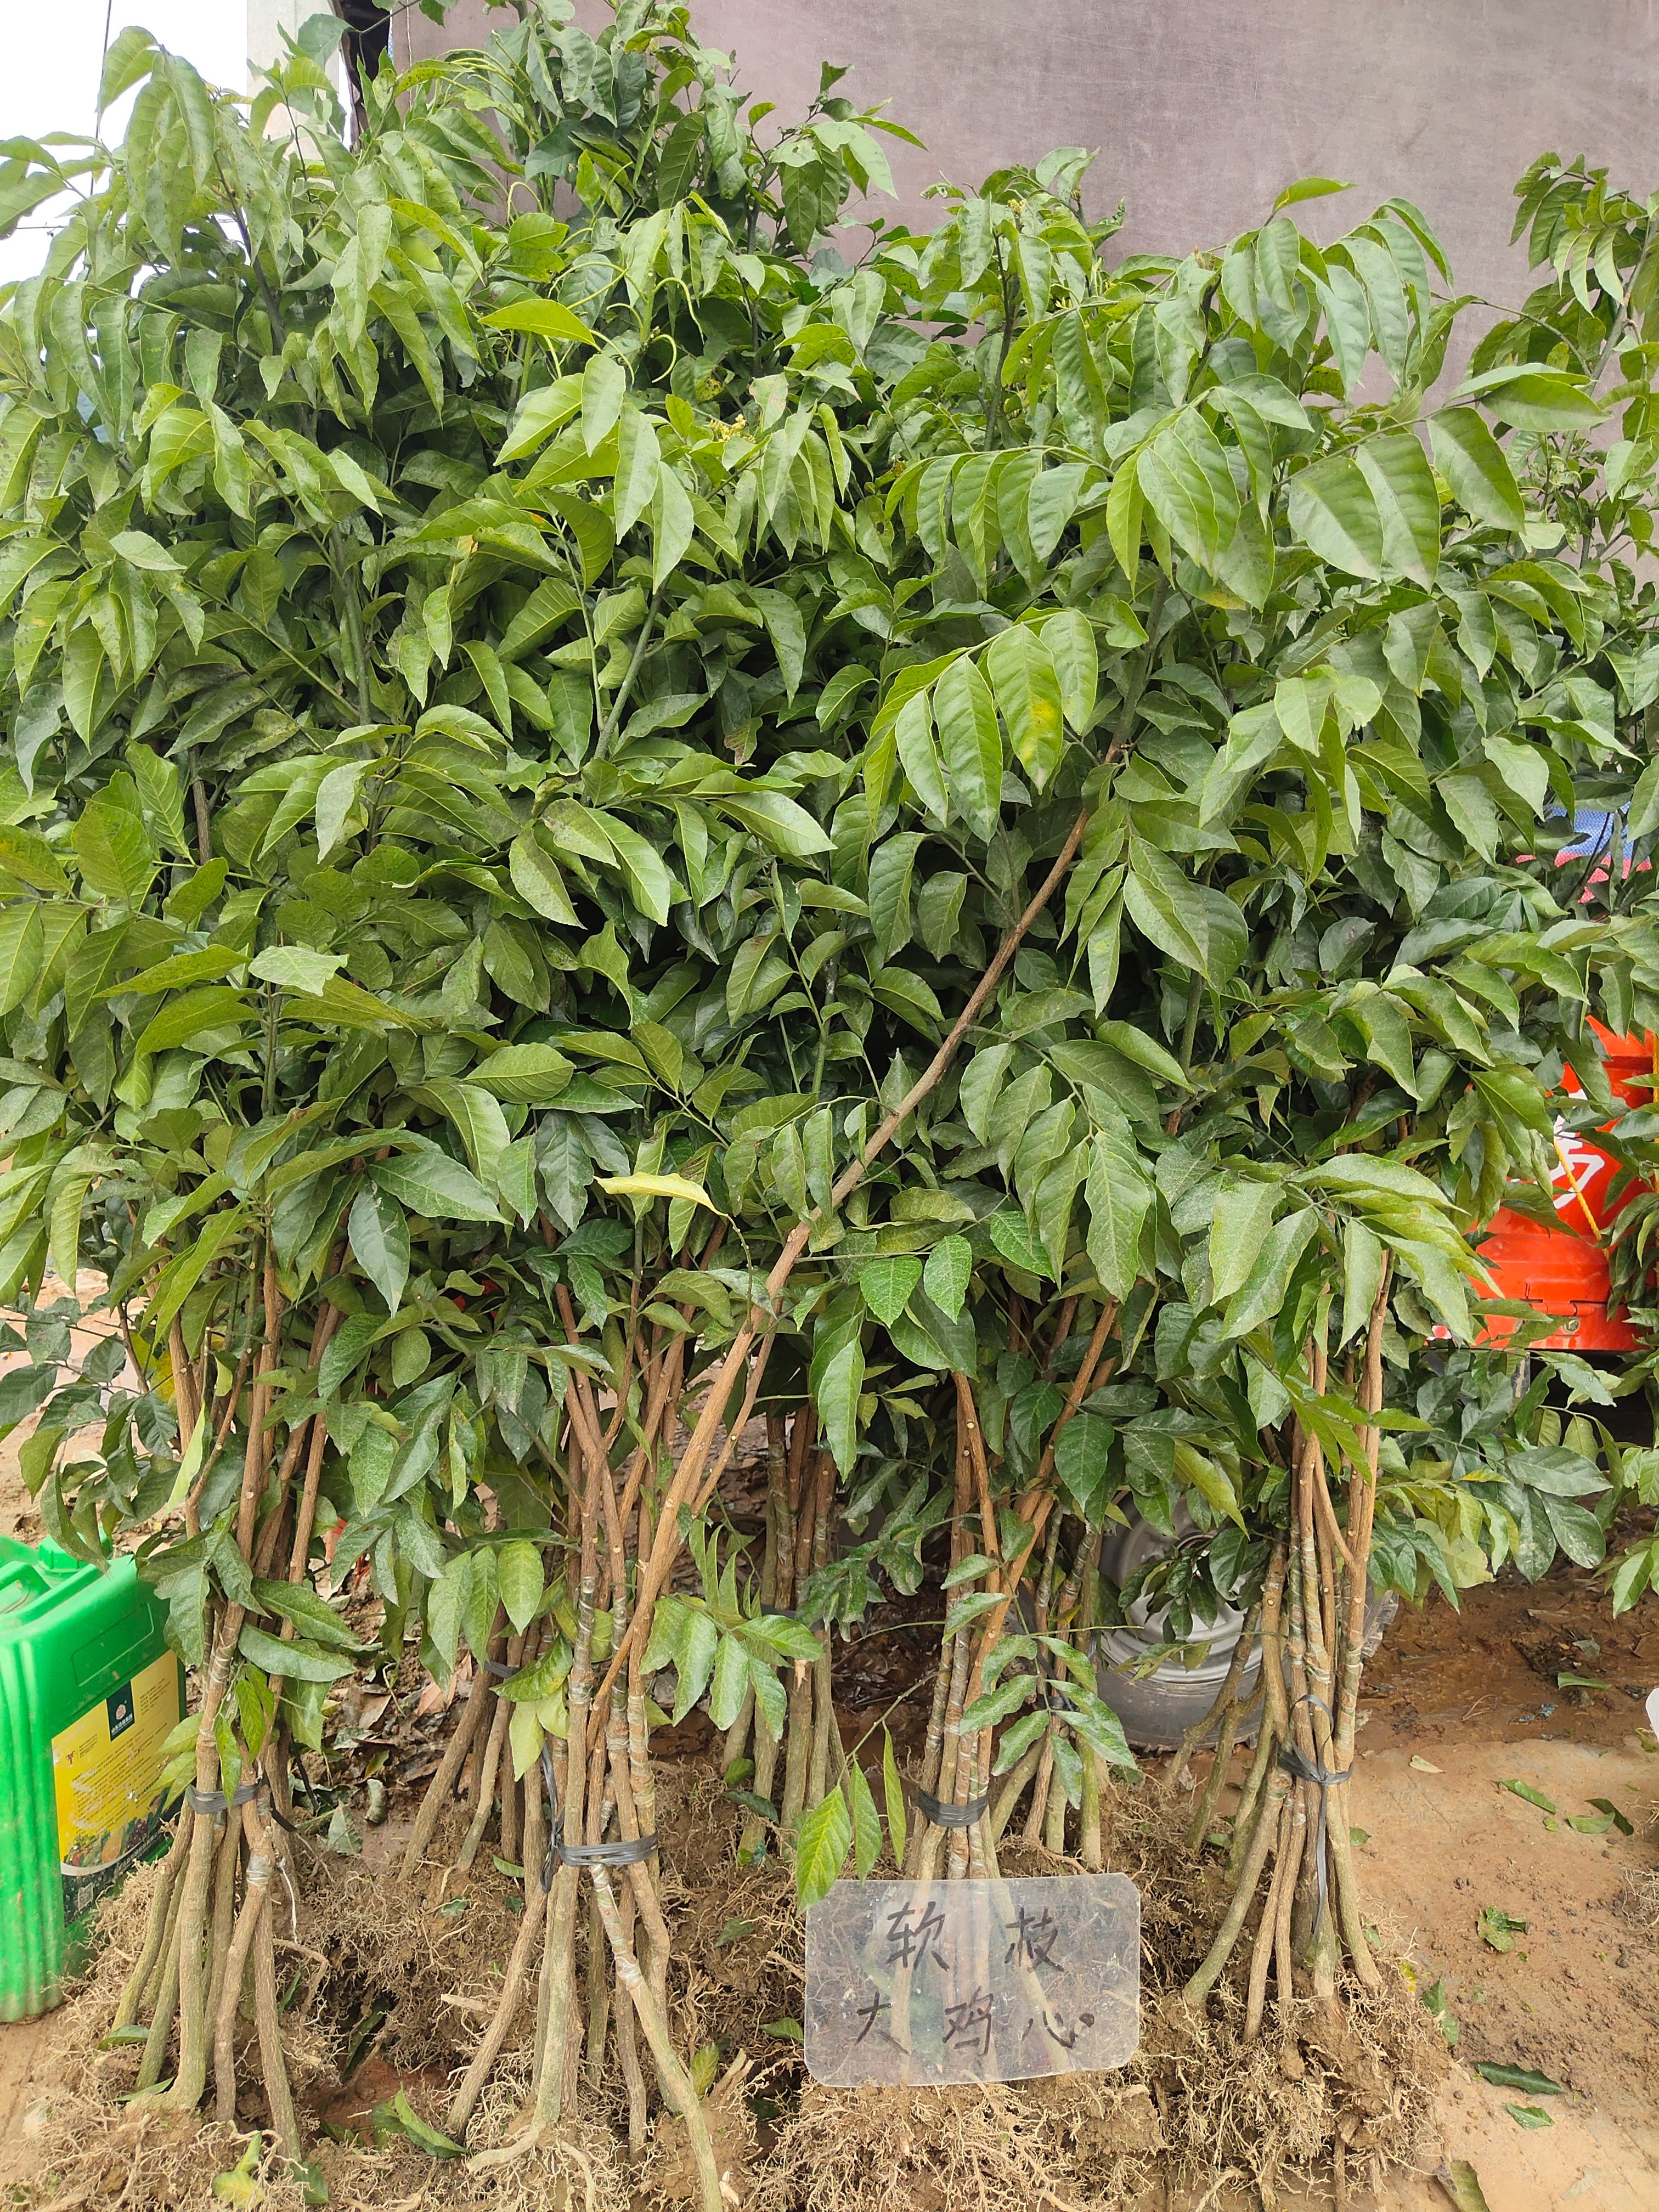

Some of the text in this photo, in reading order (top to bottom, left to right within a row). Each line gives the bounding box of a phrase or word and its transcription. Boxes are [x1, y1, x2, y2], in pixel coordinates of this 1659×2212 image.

[887, 1901, 1064, 1971] 软枝
[855, 1986, 1094, 2056] 大鸡心
